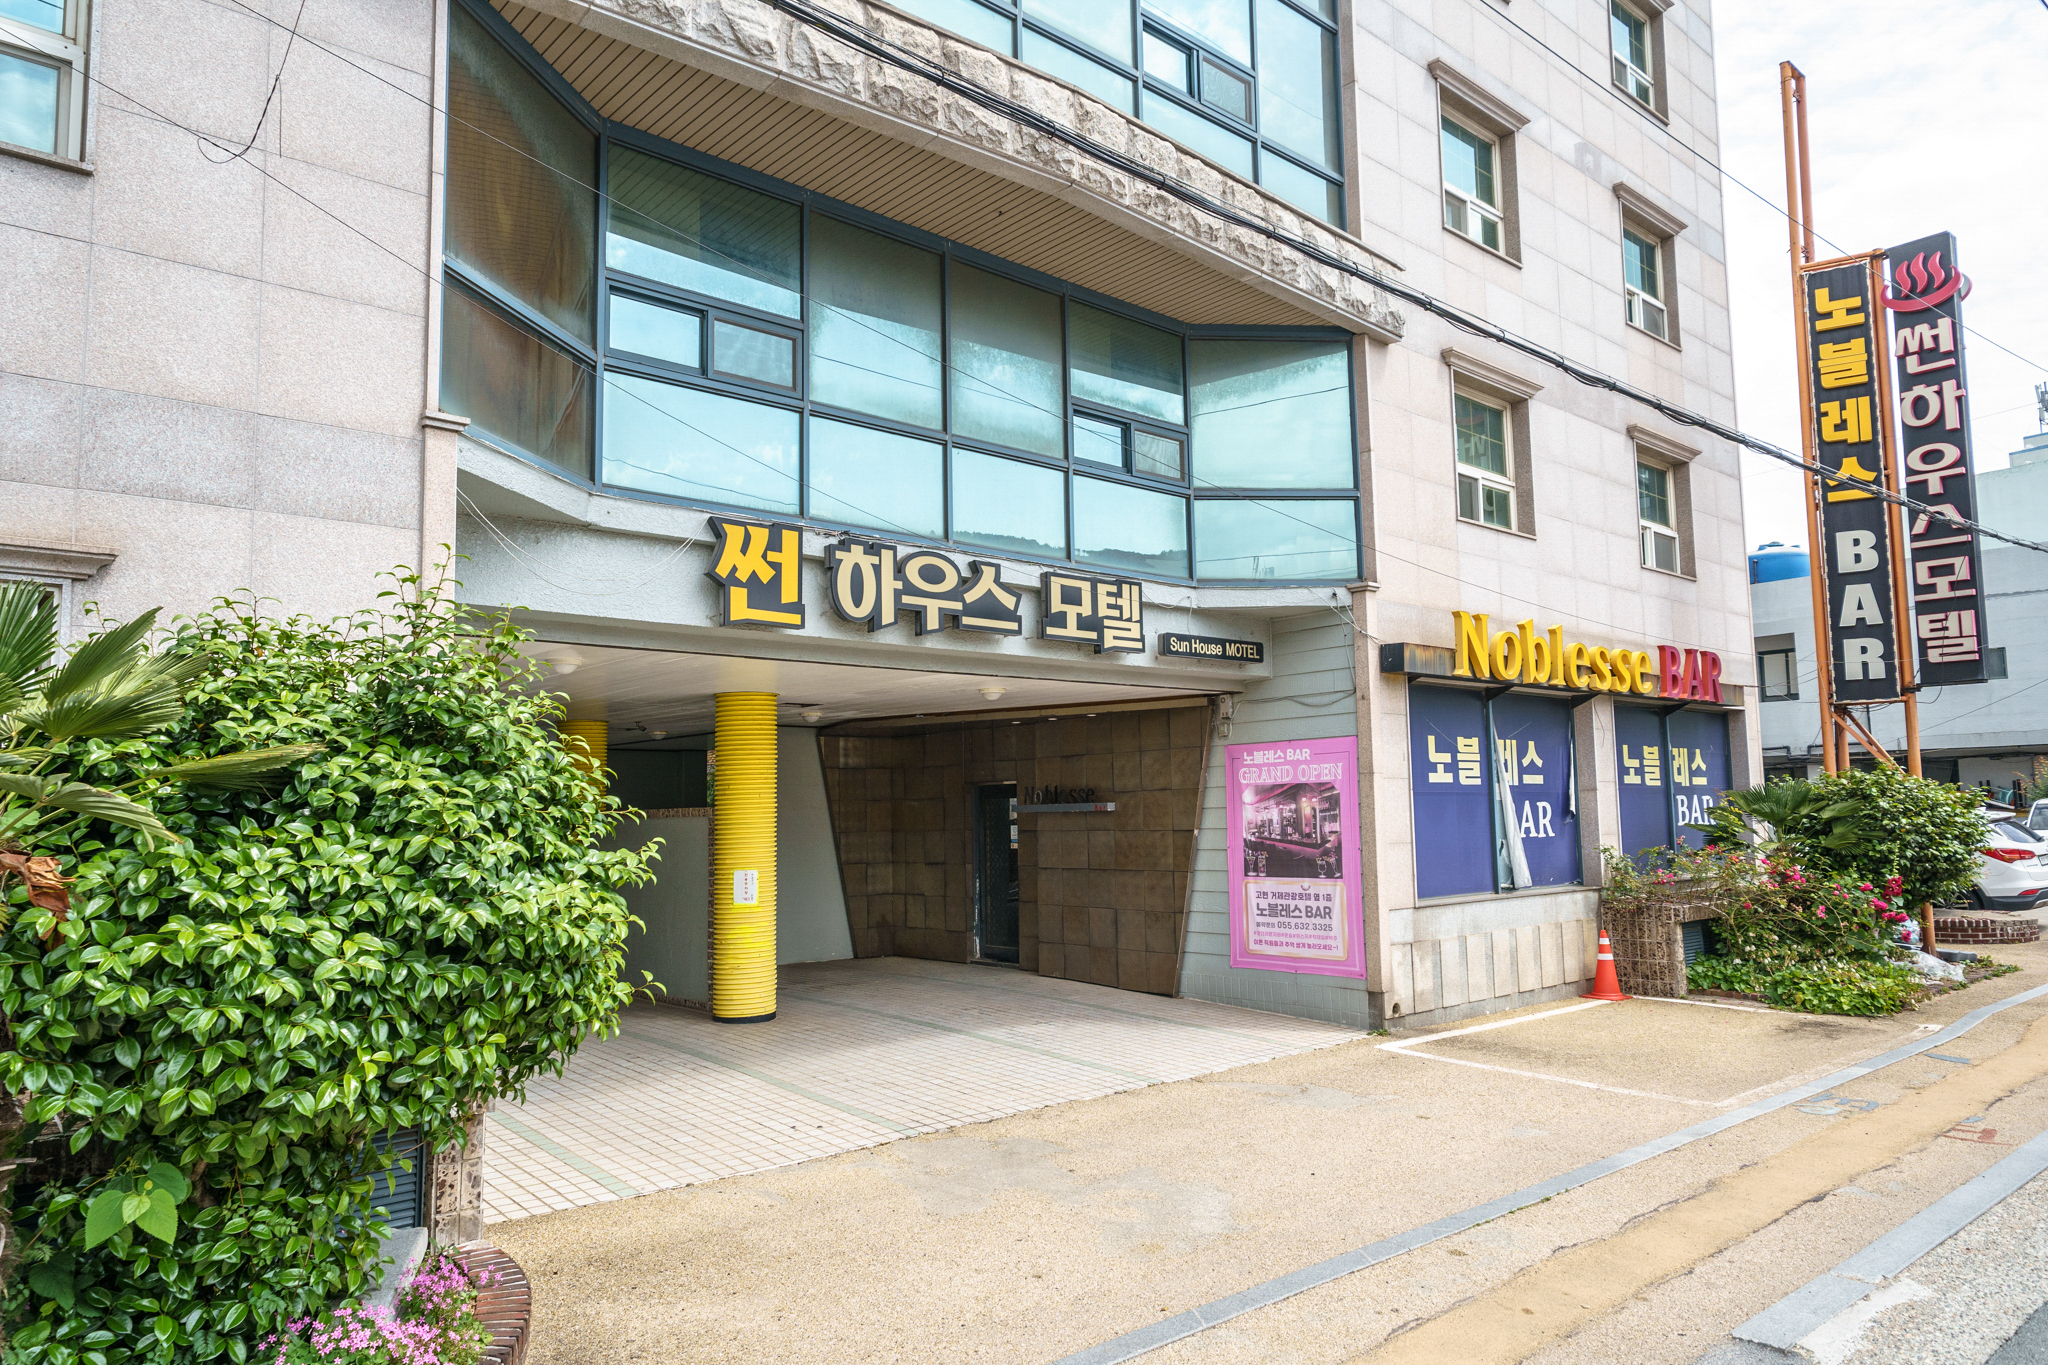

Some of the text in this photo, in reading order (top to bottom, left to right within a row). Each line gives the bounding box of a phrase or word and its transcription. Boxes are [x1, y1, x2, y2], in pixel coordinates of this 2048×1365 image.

[1814, 286, 1878, 502] 노블레스
[713, 522, 1143, 650] 썬 하우스 모텔
[1835, 529, 1886, 681] BAR
[1170, 636, 1260, 659] Sun House MOTEL
[1451, 610, 1725, 703] Noblesse BAR
[1238, 763, 1343, 784] GRAND OPEN
[1243, 748, 1311, 764] 노블레스 BAR
[1622, 744, 1708, 787] 노블레스
[1519, 800, 1556, 839] AR
[1255, 902, 1333, 920] 노블레스 BAR
